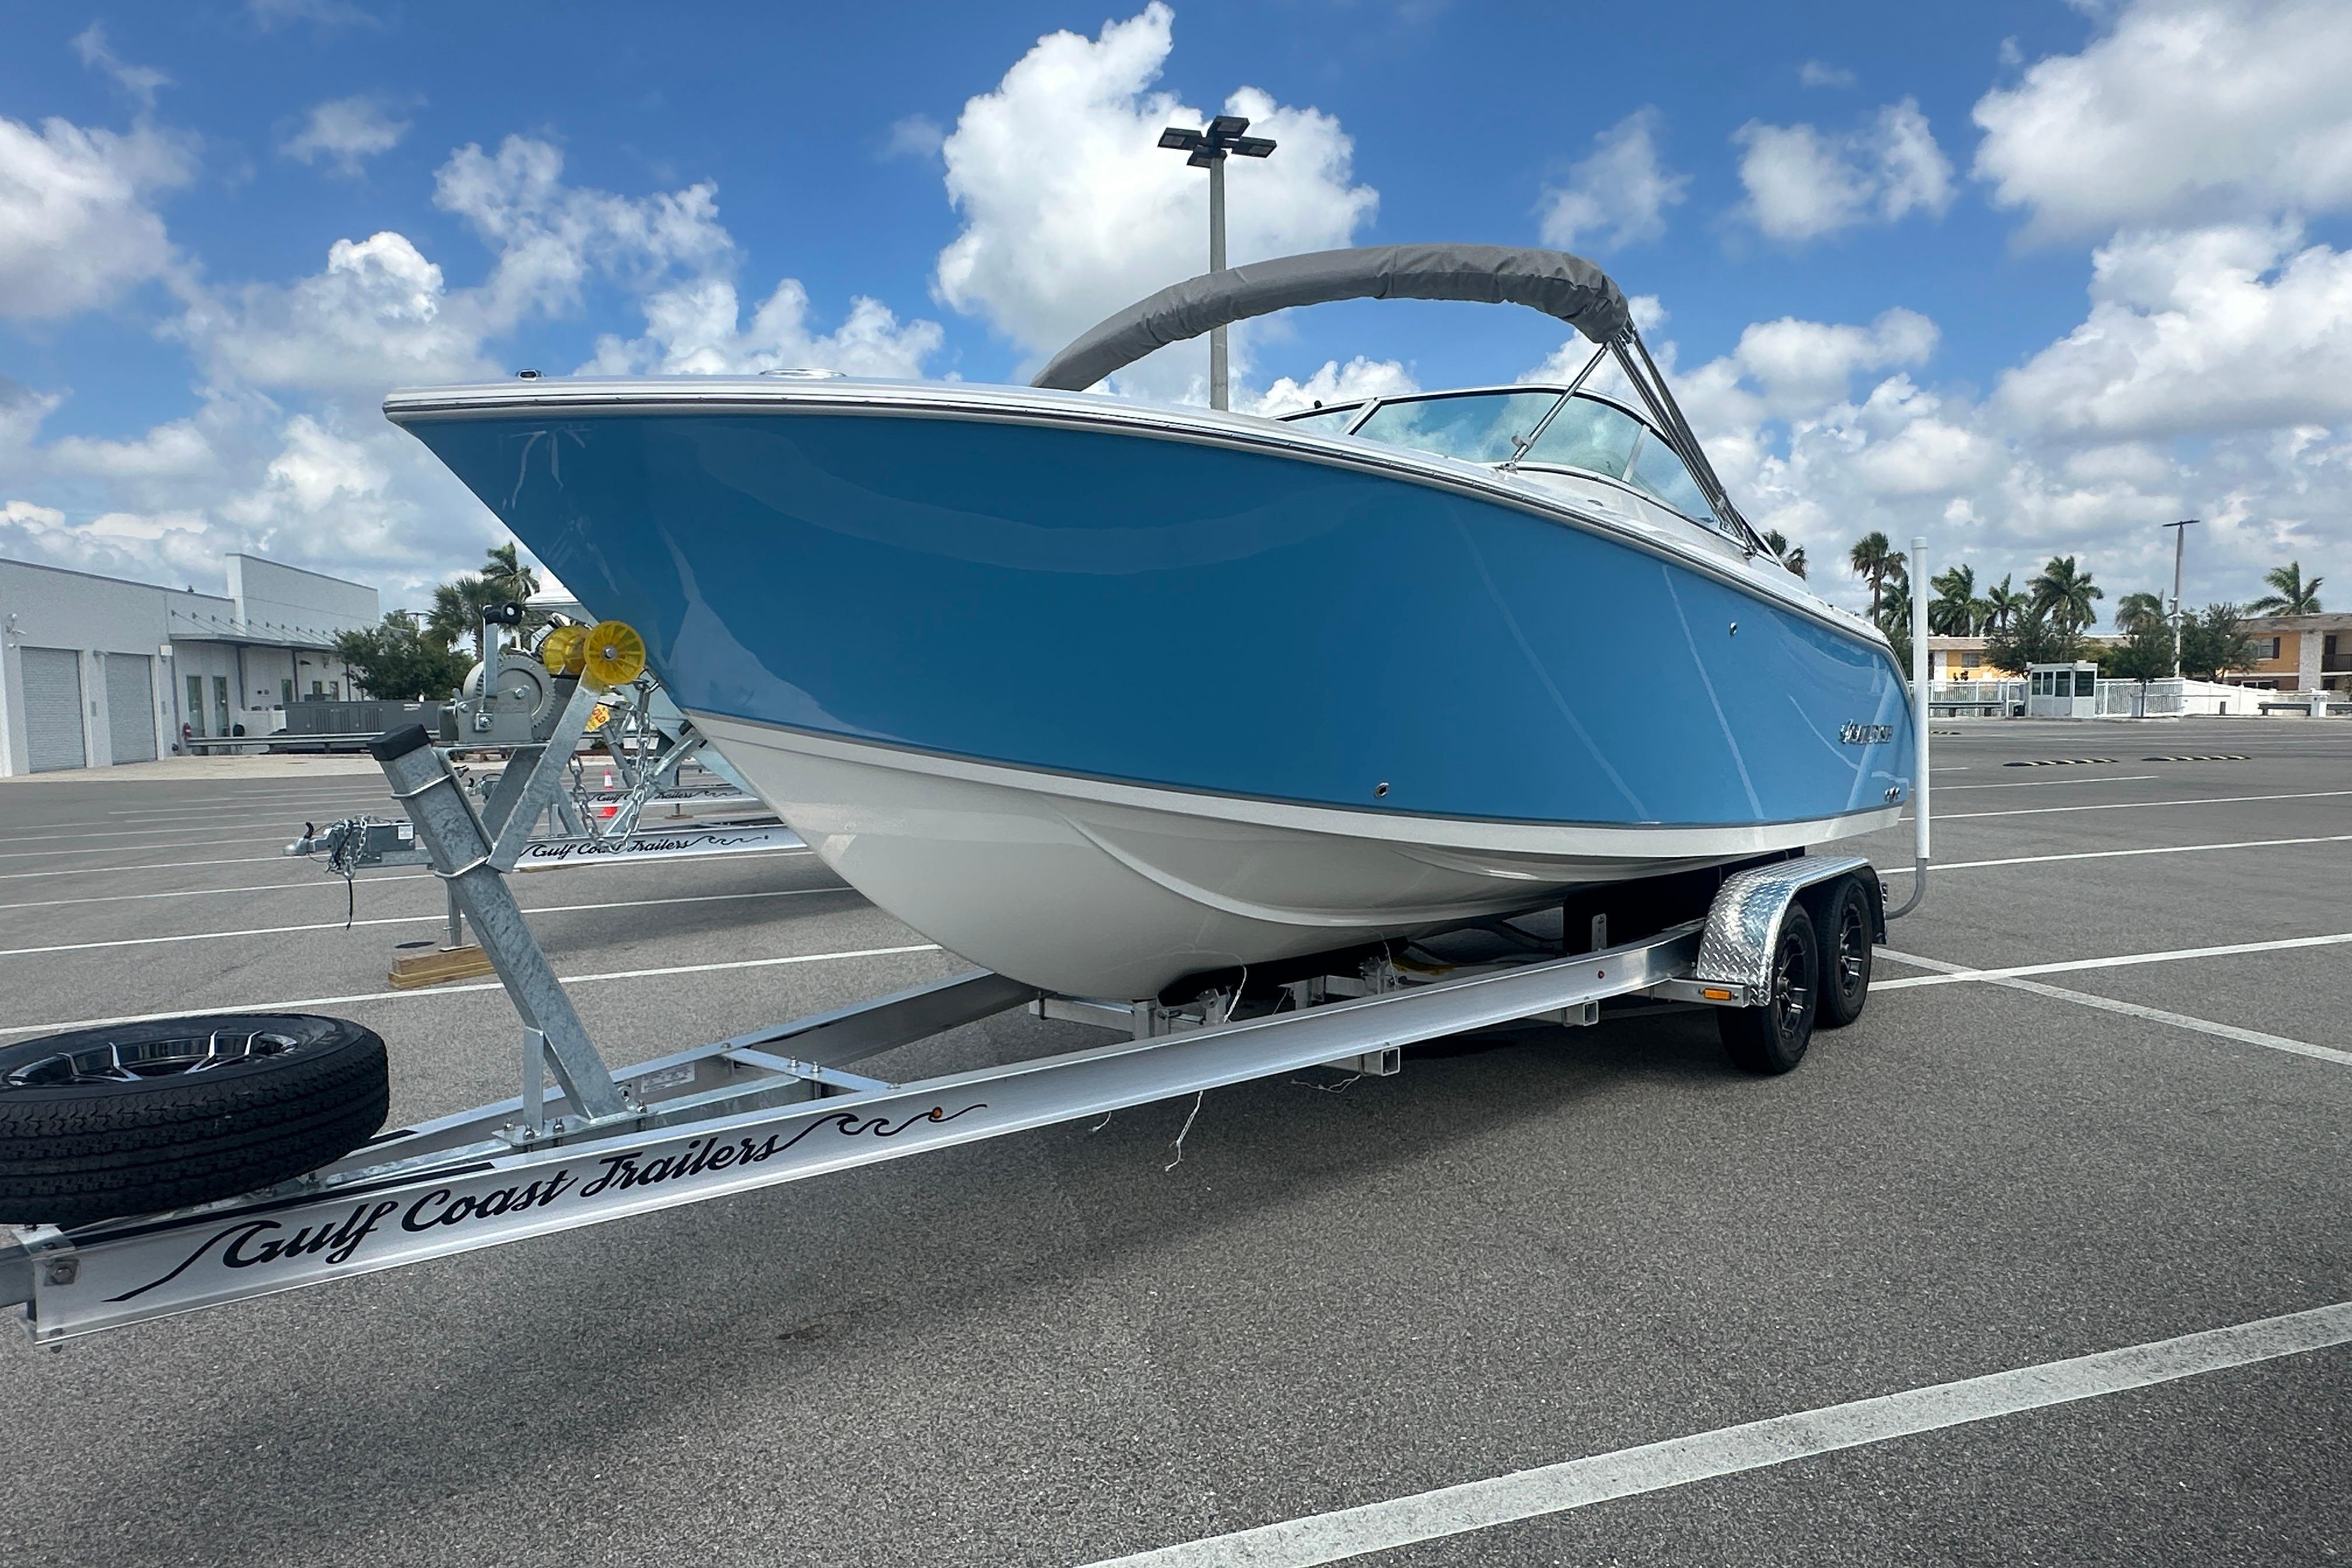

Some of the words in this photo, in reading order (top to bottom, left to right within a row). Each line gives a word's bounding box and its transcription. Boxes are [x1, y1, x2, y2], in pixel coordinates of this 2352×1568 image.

[532, 844, 576, 859] Gulf
[578, 842, 624, 855] Cot
[627, 839, 689, 852] Trailers
[222, 1200, 399, 1268] Gulf
[401, 1170, 579, 1232] Coast
[580, 1134, 783, 1197] Trailers
